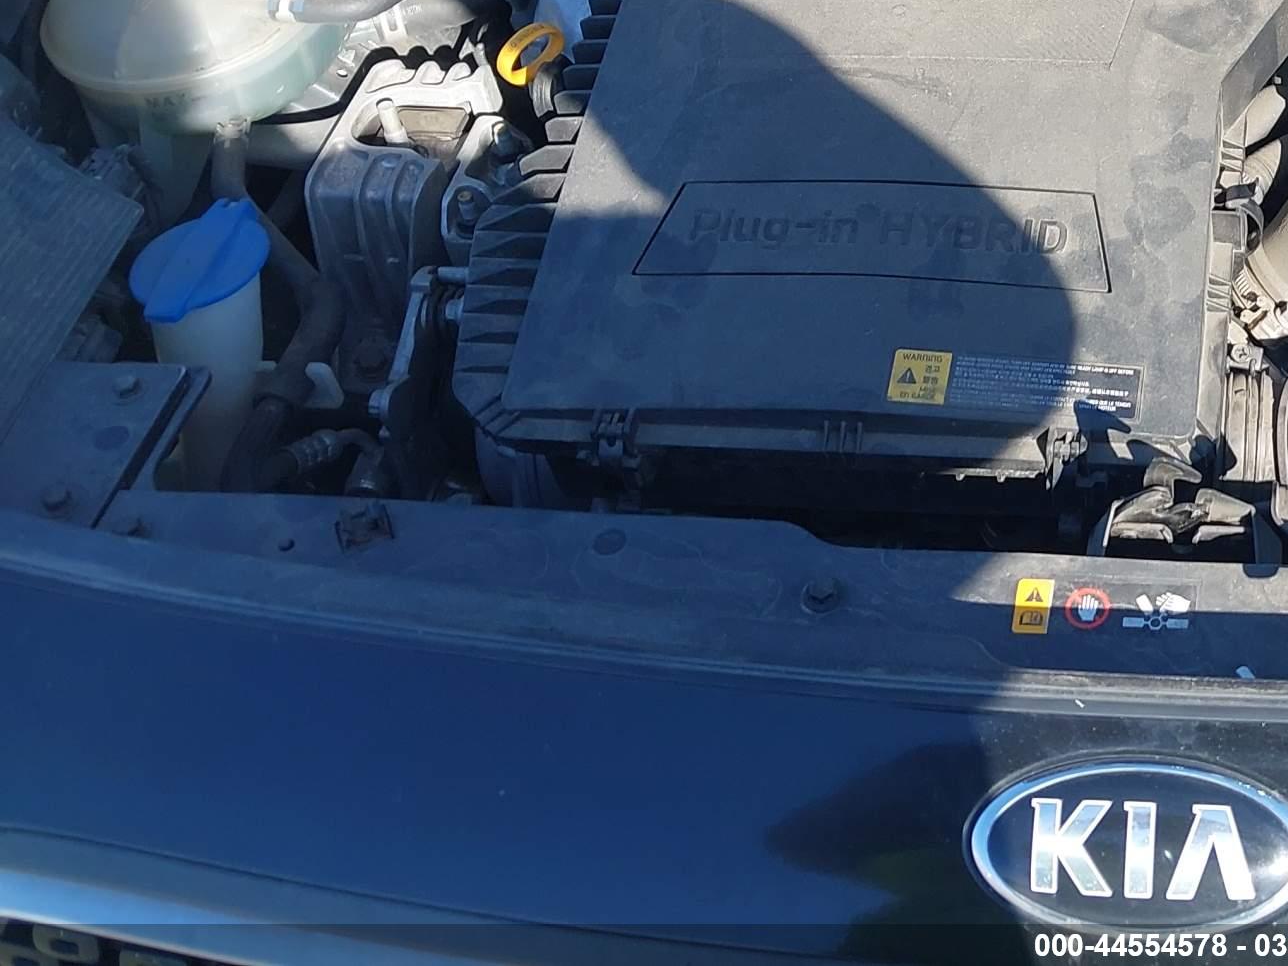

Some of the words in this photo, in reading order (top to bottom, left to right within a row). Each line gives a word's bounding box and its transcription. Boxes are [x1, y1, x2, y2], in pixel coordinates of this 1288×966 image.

[689, 208, 860, 248] Plug-in
[878, 206, 1070, 256] HYBRID
[902, 353, 943, 363] WARNING
[1030, 797, 1257, 901] KIA
